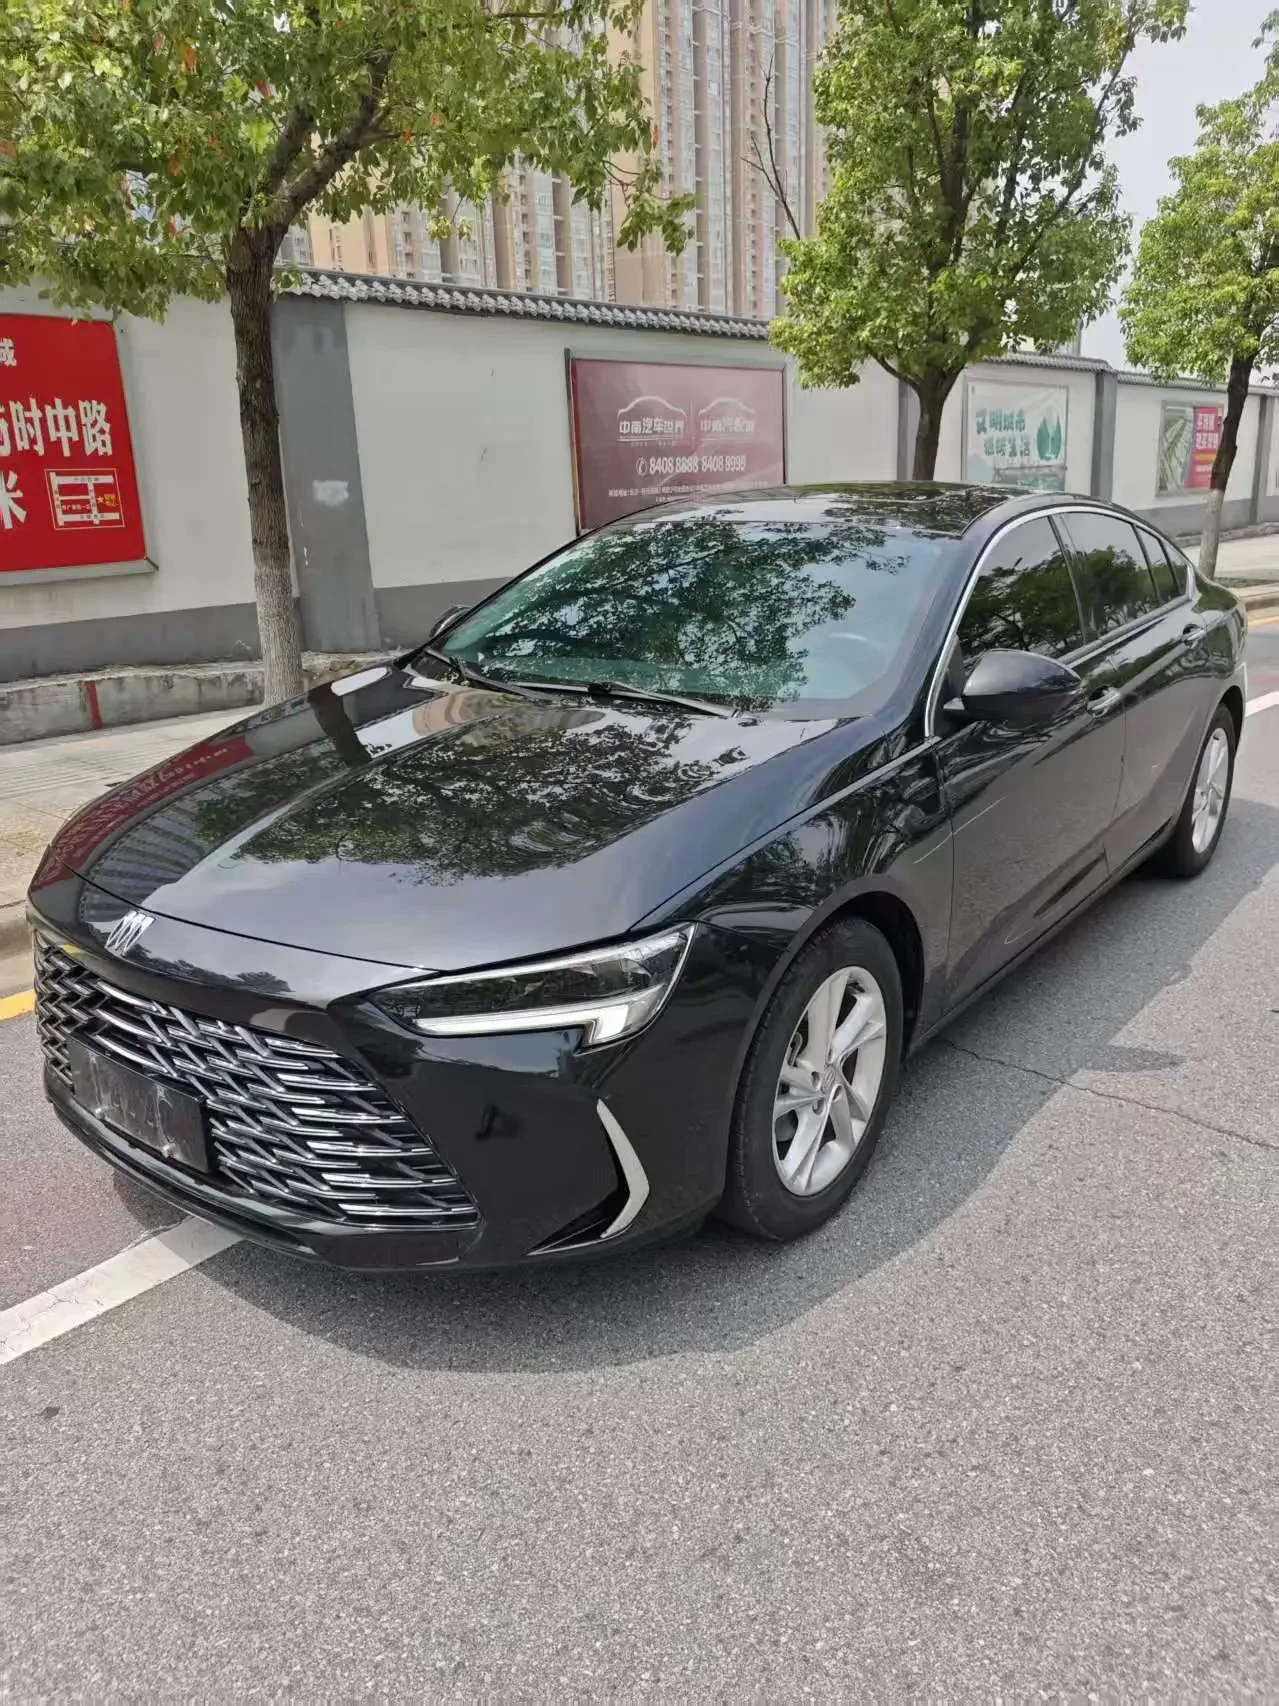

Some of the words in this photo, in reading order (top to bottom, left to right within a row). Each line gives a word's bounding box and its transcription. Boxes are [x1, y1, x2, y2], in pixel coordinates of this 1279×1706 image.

[619, 417, 685, 434] 中南汽车世界
[649, 456, 674, 474] 8408
[701, 455, 724, 472] 8408
